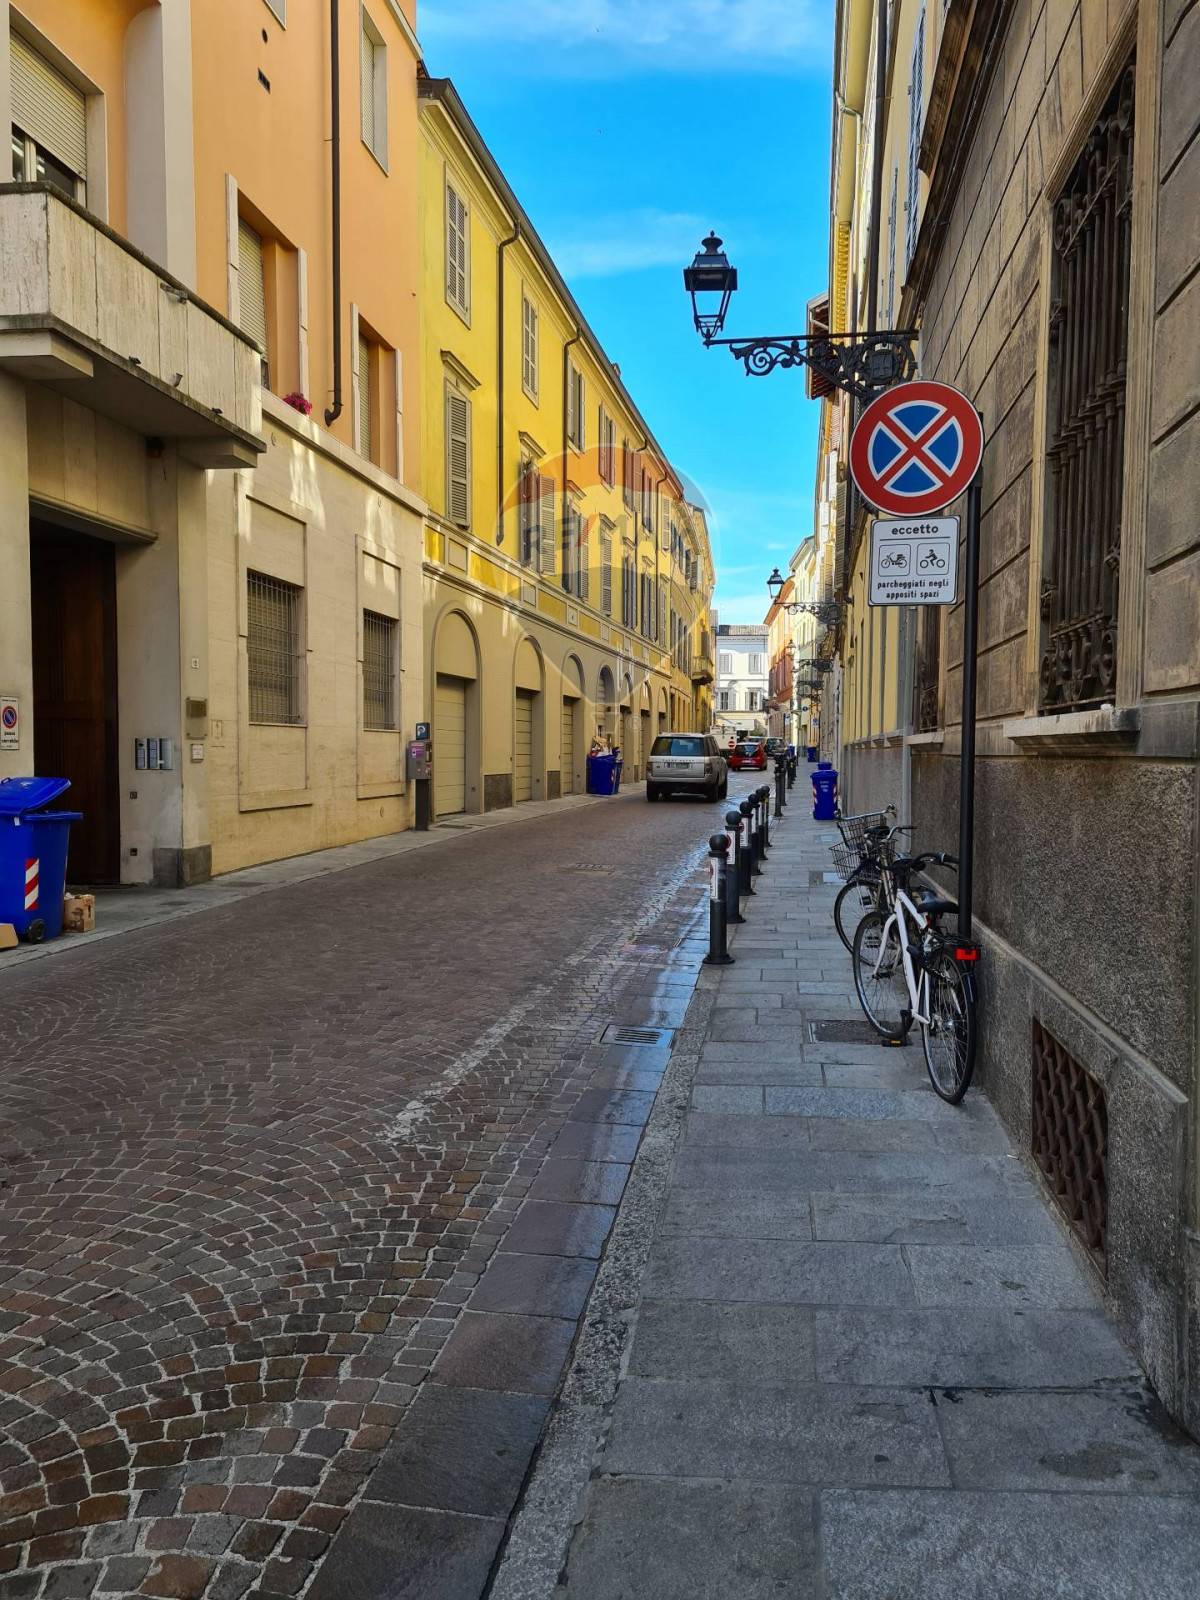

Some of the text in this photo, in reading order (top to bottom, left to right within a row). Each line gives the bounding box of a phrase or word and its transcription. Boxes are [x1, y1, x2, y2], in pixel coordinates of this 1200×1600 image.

[891, 524, 939, 535] eccetto
[877, 578, 949, 589] parcheggiati negli
[886, 590, 939, 600] appositi spazi
